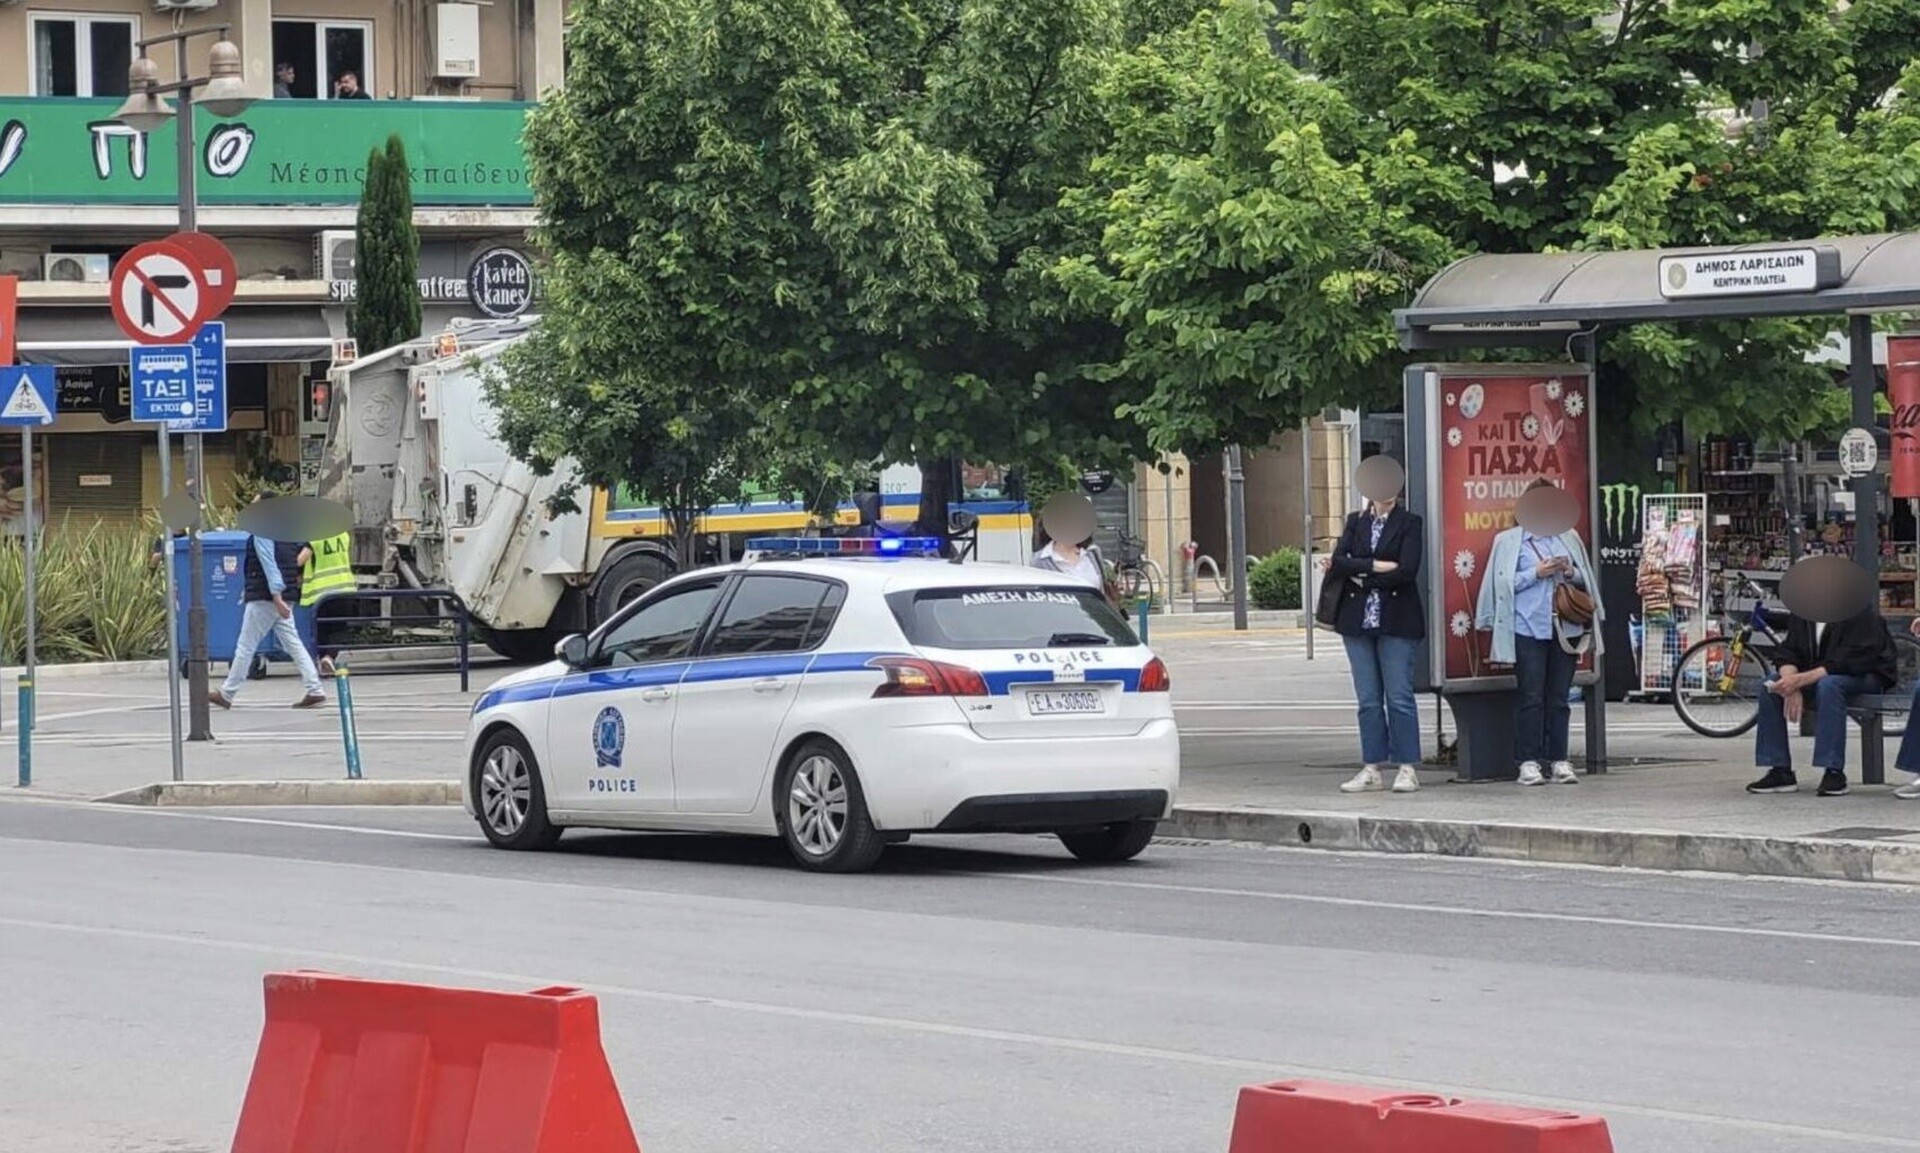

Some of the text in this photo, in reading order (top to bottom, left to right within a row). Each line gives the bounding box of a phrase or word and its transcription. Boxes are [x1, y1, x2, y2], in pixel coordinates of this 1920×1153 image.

[270, 161, 365, 187] Μέσης
[1695, 255, 1804, 273] ΔΗΜΟΣ ΛΑΡΙΣΑΙΩΝ
[416, 276, 463, 297] offee
[1713, 274, 1786, 287] ΚΕΝΤΡΙΚΗ ΠΛΑΤΕΙΑ
[141, 379, 187, 397] ΤΑΞΙ
[1478, 411, 1540, 442] ΚΑΙ ΤΟ
[1467, 445, 1562, 475] ΠΑΣΧΑ
[1463, 481, 1488, 499] ΤΟ
[962, 590, 1081, 606] ΑΜΕΣΗ ΔΡΑΣΗ
[1014, 650, 1104, 663] POLICE
[588, 779, 637, 792] POLICE
